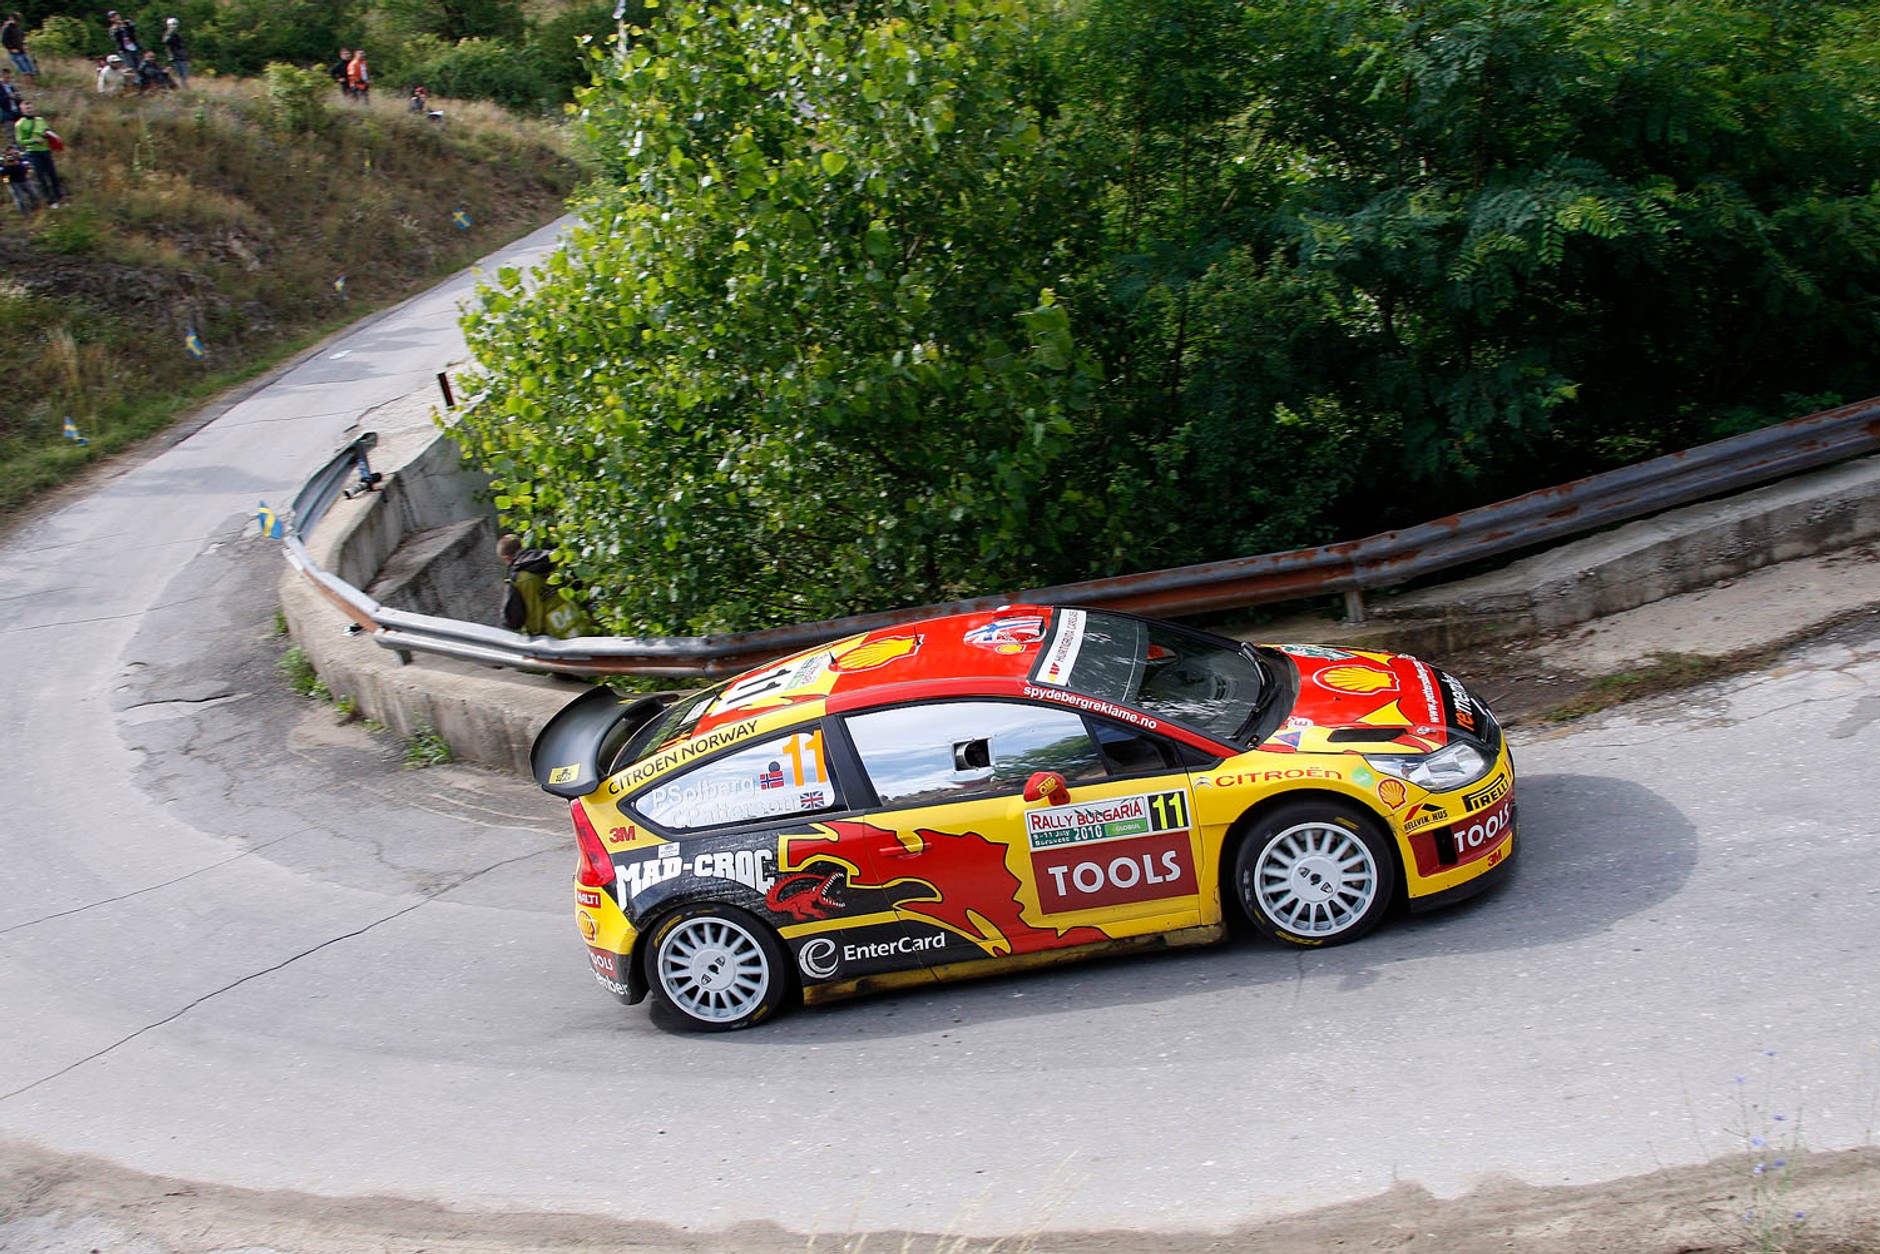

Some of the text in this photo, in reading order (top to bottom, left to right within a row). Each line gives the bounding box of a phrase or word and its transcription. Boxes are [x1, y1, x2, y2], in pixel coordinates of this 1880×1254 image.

[1023, 686, 1157, 729] spydebergreklame.no
[682, 719, 758, 759] NORWAY
[782, 729, 828, 787] 11
[1152, 792, 1184, 830] 11
[1461, 772, 1509, 813] PIRELLI
[609, 825, 637, 844] 3M
[1030, 800, 1143, 831] RALLY BULGARIA
[1073, 824, 1103, 841] 2010
[1432, 809, 1448, 821] HUS
[1454, 802, 1510, 853] TOOLS
[615, 849, 775, 912] MAD-CROC
[1047, 850, 1181, 897] TOOLS
[843, 932, 946, 961] EnterCard
